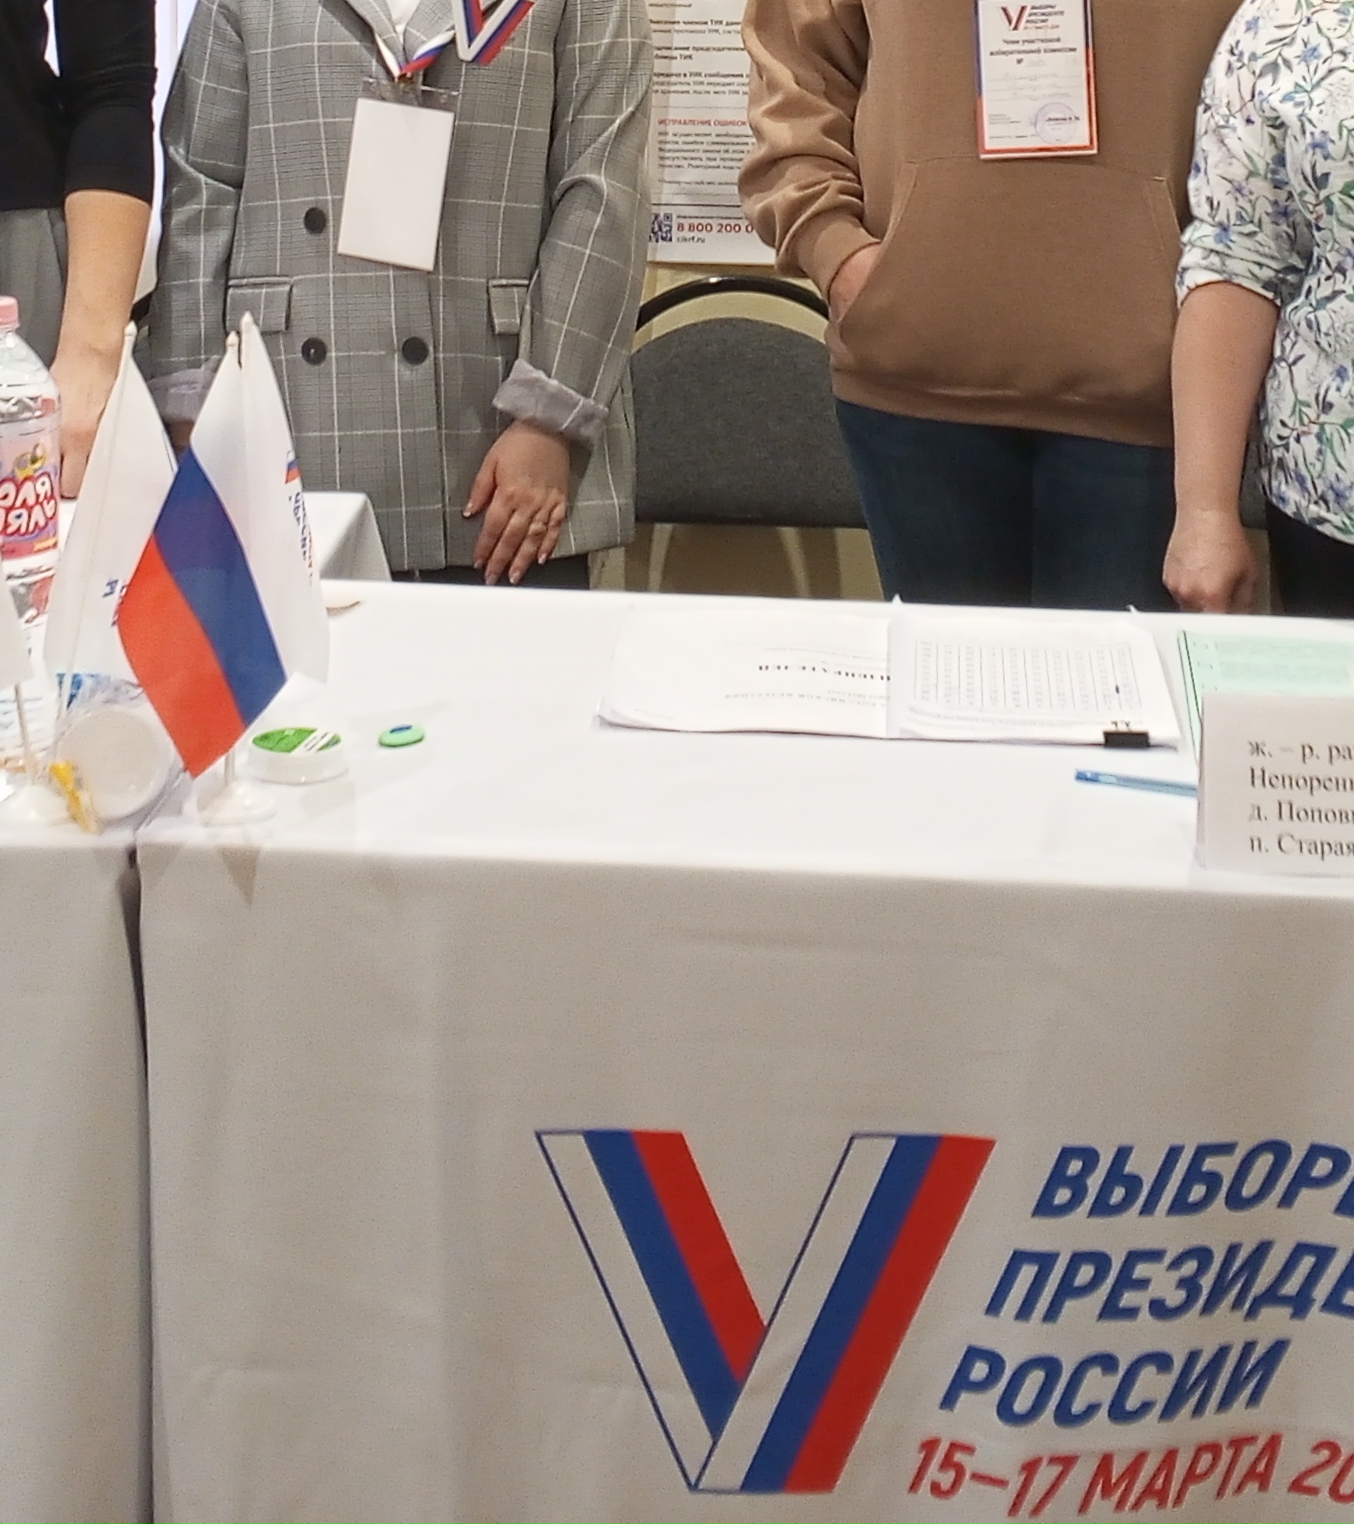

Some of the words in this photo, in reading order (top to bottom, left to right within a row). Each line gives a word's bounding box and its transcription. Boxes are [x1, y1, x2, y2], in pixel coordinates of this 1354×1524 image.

[677, 223, 684, 232] 8
[688, 223, 713, 232] 800
[717, 223, 741, 233] 200
[1248, 740, 1272, 758] ж.
[1301, 742, 1320, 764] р.
[1248, 804, 1267, 822] д.
[1249, 835, 1269, 853] п.
[938, 1339, 1289, 1429] РОССИИ
[1079, 1433, 1284, 1517] МАРТА
